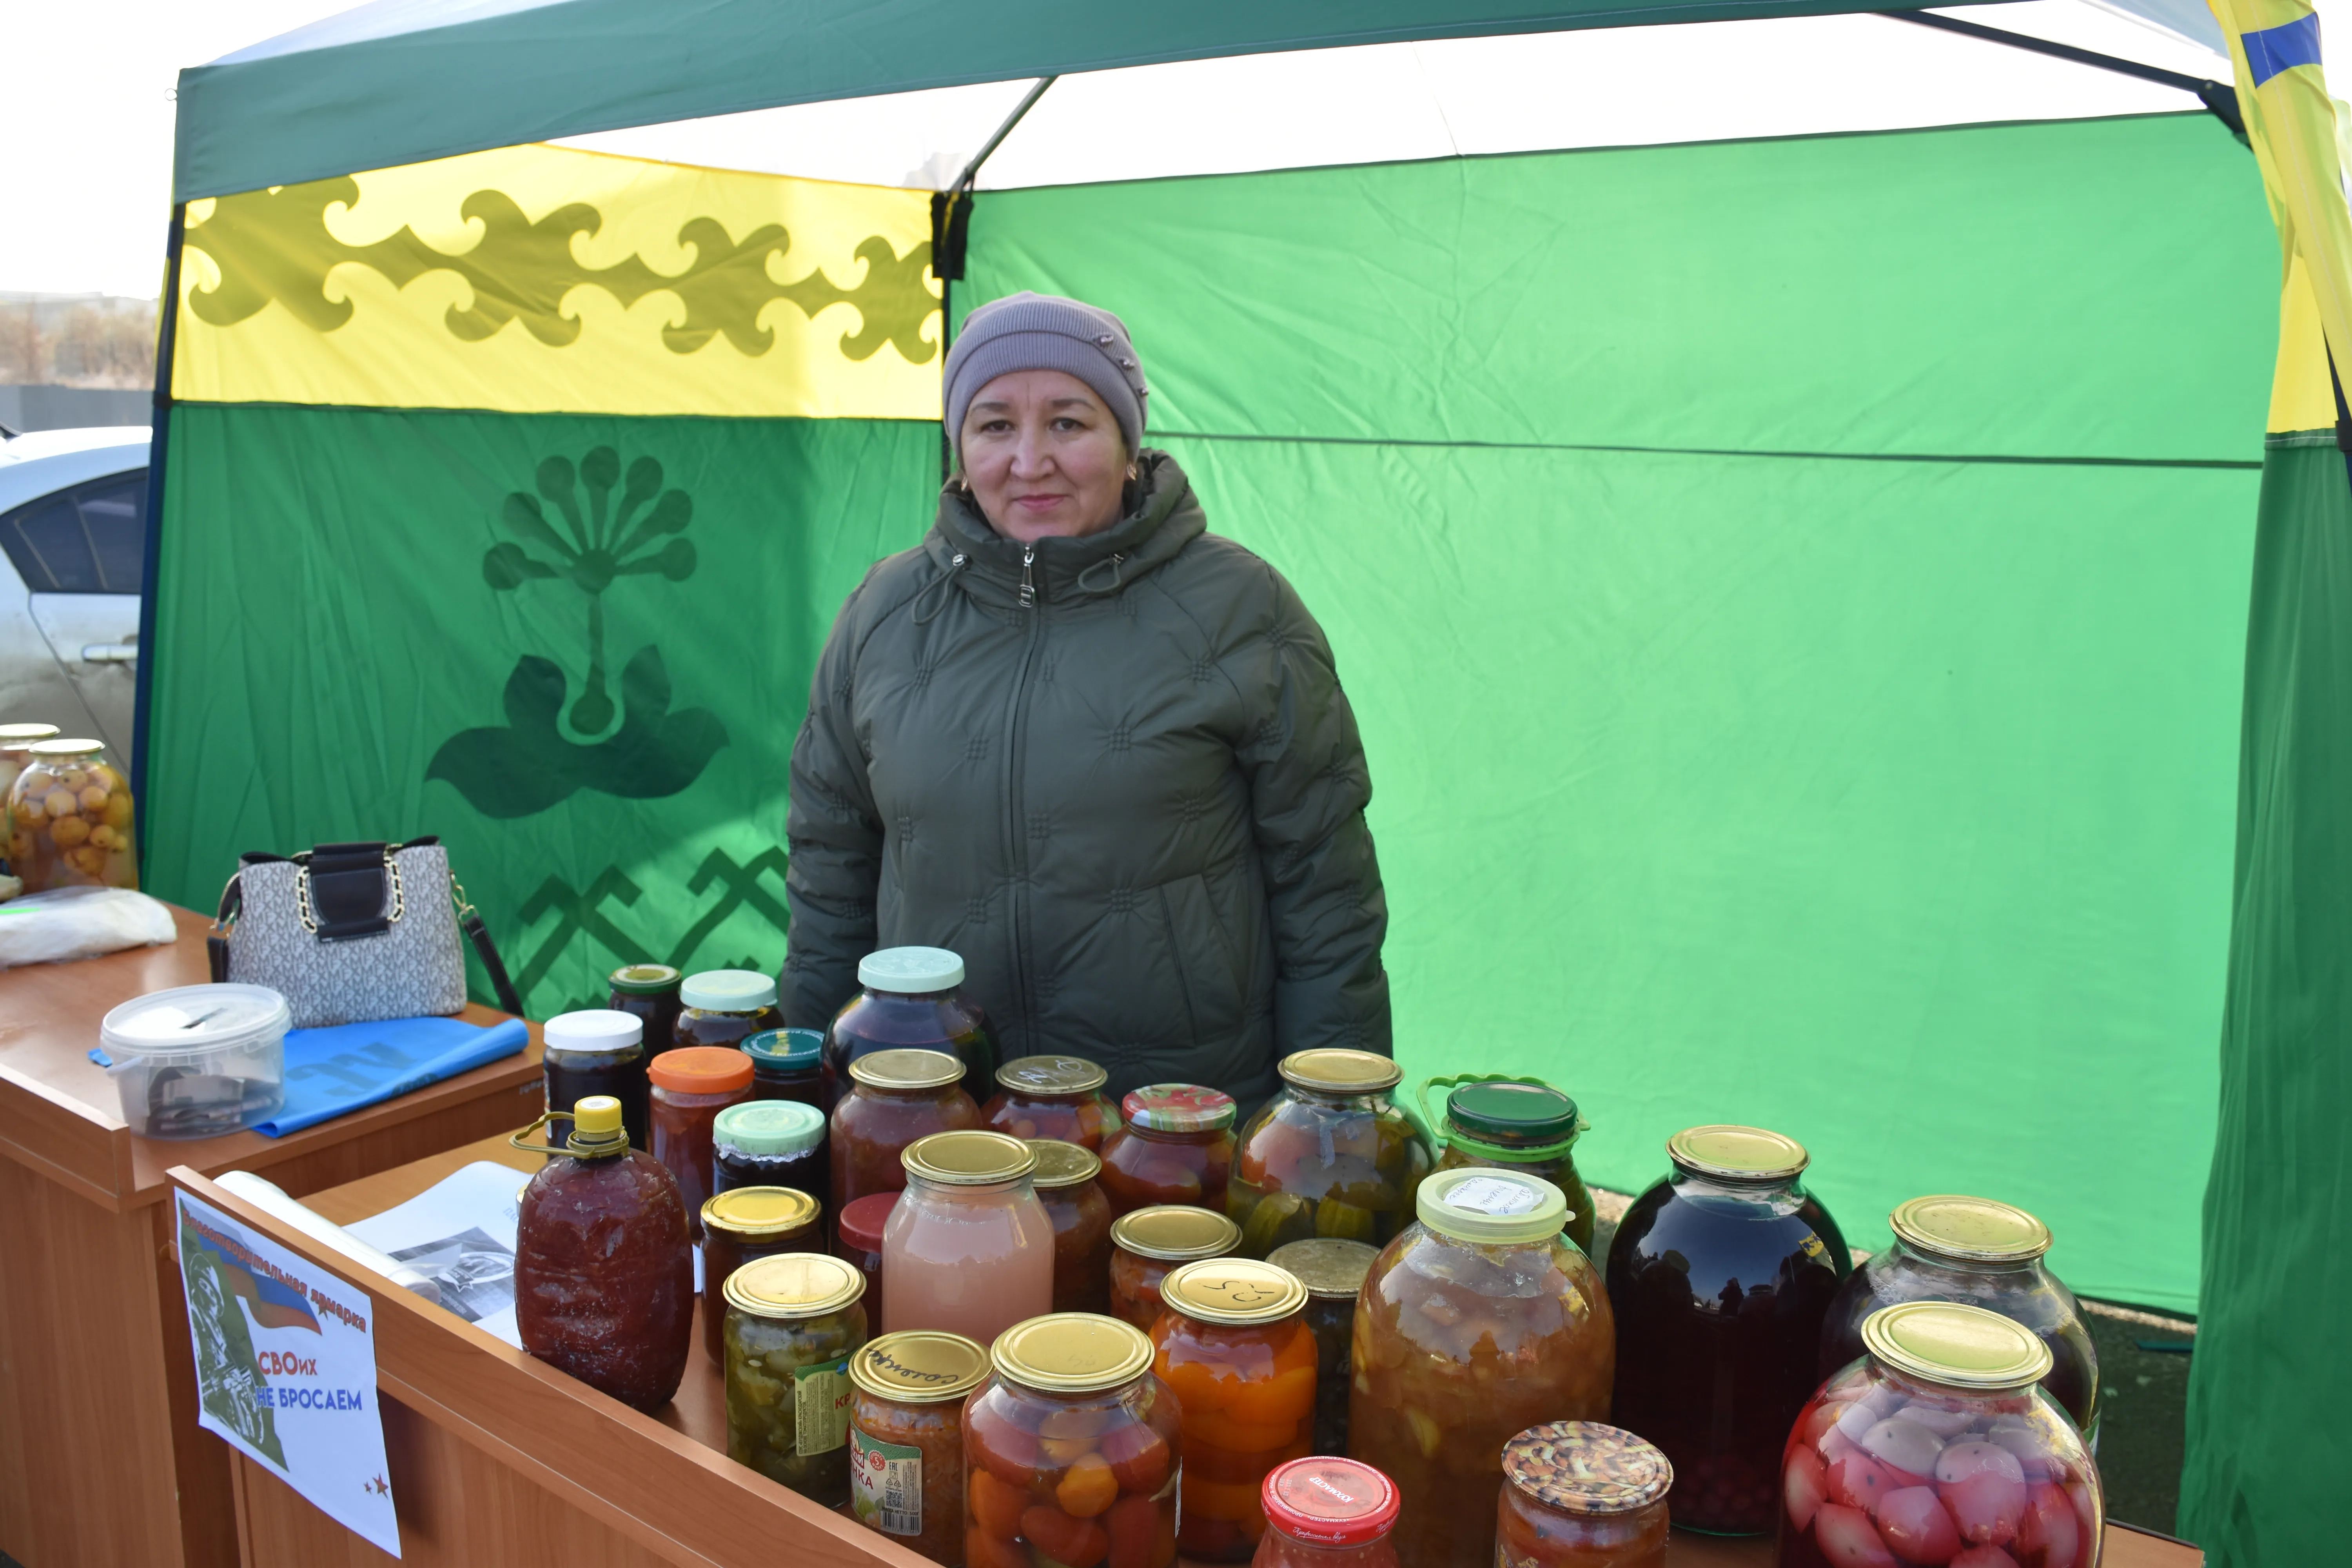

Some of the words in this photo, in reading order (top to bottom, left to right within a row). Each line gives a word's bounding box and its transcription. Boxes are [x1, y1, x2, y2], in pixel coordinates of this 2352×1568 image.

[183, 1209, 307, 1298] Благотворительная
[311, 1289, 366, 1333] ярмарка
[258, 1351, 318, 1375] СВОих
[256, 1387, 275, 1408] НЕ
[279, 1388, 362, 1410] БРОСАЕМ
[875, 1457, 879, 1465] 5
[1343, 1458, 1377, 1474] ГАРАНТИРУЕТ
[1308, 1476, 1354, 1503] КУХМАСТЕР
[1272, 1495, 1303, 1517] ПРОИЗВЕДЕНО
